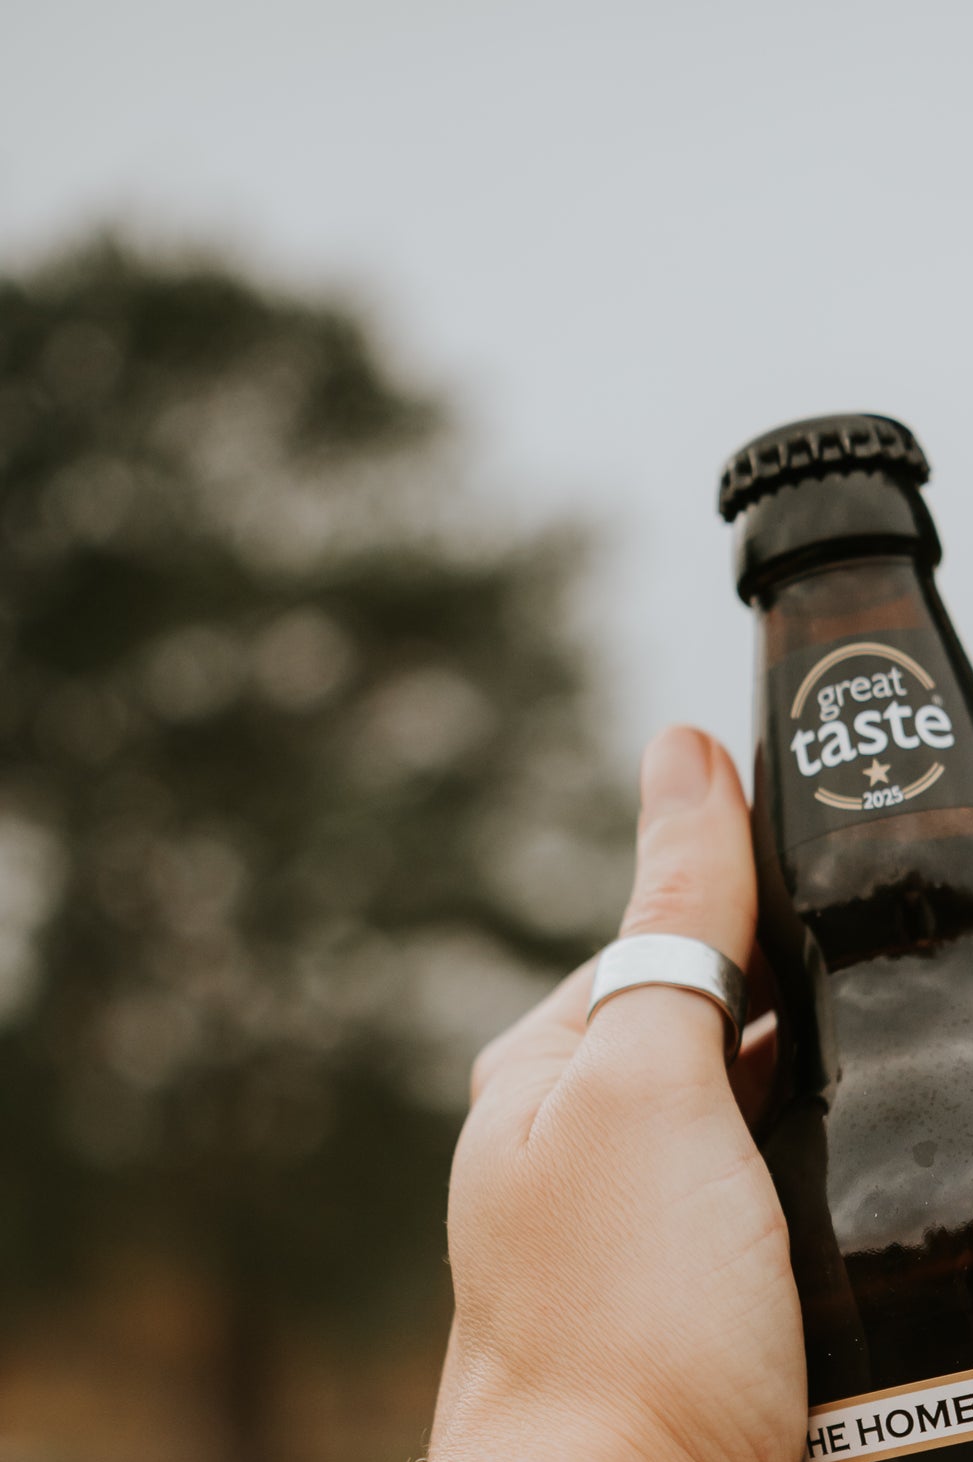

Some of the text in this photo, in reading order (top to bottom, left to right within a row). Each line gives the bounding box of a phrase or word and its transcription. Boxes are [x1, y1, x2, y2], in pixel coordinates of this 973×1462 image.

[817, 666, 907, 722] great
[790, 701, 955, 777] taste
[862, 785, 904, 810] 2025
[806, 1421, 851, 1459] HE
